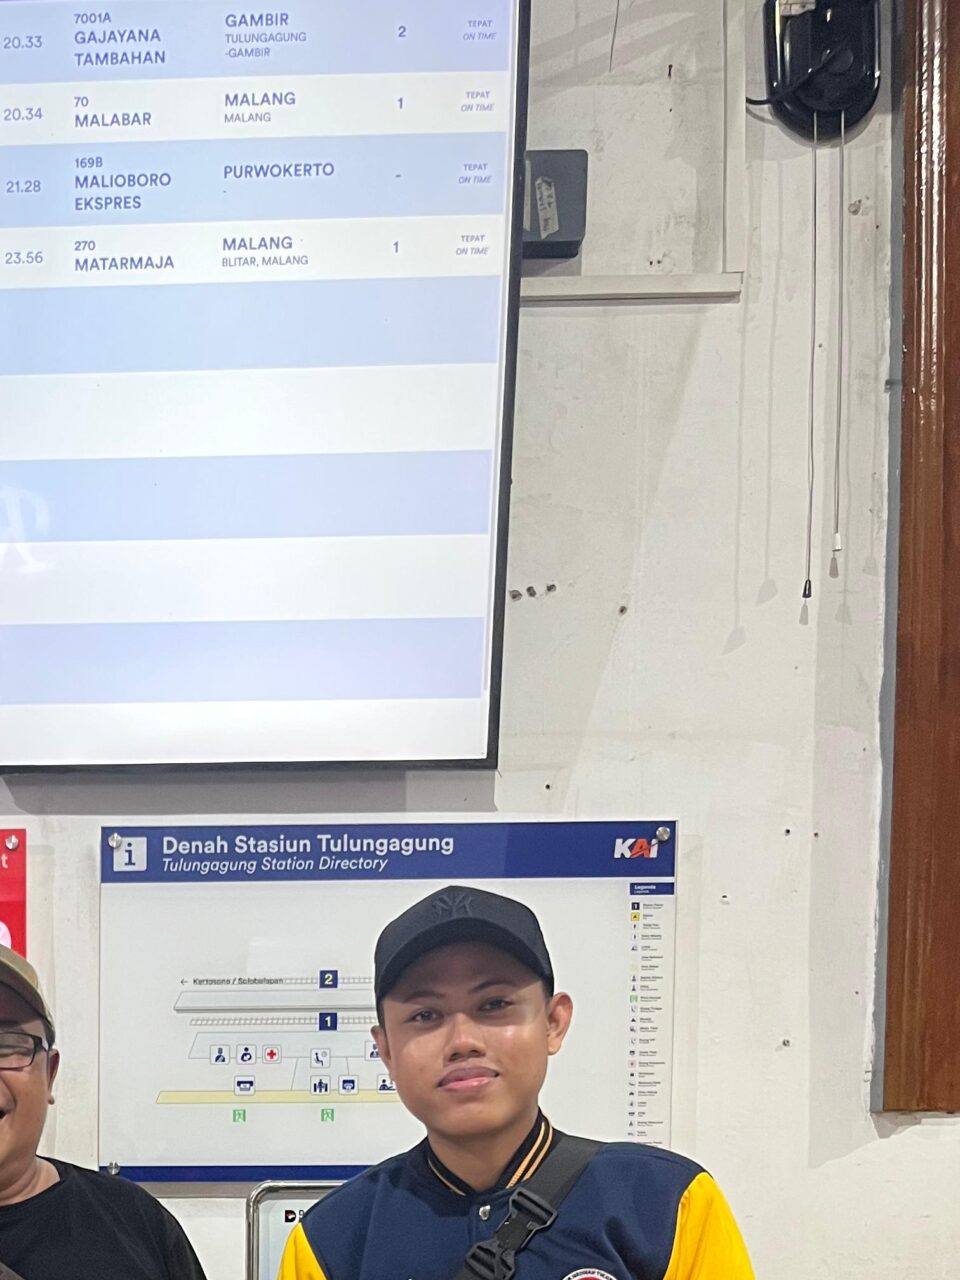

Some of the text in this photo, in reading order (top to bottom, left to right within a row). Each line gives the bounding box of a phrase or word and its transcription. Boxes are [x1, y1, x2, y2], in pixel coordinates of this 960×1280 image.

[74, 12, 111, 24] 7001A
[225, 13, 289, 27] GAMBIR
[468, 20, 493, 28] TEPAT
[75, 29, 161, 44] GAJAYANA
[225, 32, 307, 44] TULUNGAGUNG
[398, 26, 407, 38] 2
[463, 32, 497, 40] ON TIME
[3, 36, 42, 49] 20.33
[75, 51, 166, 66] TAMBAHAN
[225, 47, 271, 59] -GAMBIR
[224, 92, 296, 107] MALANG
[466, 90, 490, 99] TEPAT
[74, 96, 89, 107] 70
[397, 97, 404, 109] 1
[461, 103, 494, 112] ON TIME
[3, 108, 42, 121] 20.34
[75, 112, 152, 128] MALABAR
[224, 112, 271, 124] MALANG
[75, 157, 103, 169] 169B
[463, 163, 488, 171] TEPAT
[224, 162, 335, 179] PURWOKERTO
[75, 173, 172, 189] MALIOBORO
[458, 175, 493, 184] ON TIME
[6, 180, 41, 193] 21.28
[75, 196, 142, 211] EKSPRES
[222, 236, 293, 251] MALANG
[461, 234, 485, 243] TEPAT
[75, 241, 96, 251] 270
[393, 241, 400, 253] 1
[456, 247, 489, 256] ON TIME
[5, 251, 43, 264] 23.56
[75, 256, 175, 271] MATARMAJA
[222, 255, 309, 268] BLITAR, MALANG
[163, 834, 454, 855] Denah Stasiun Tulungagung
[613, 838, 659, 859] KAI
[162, 856, 388, 875] Tulungagung Station Directory
[324, 974, 333, 985] 2
